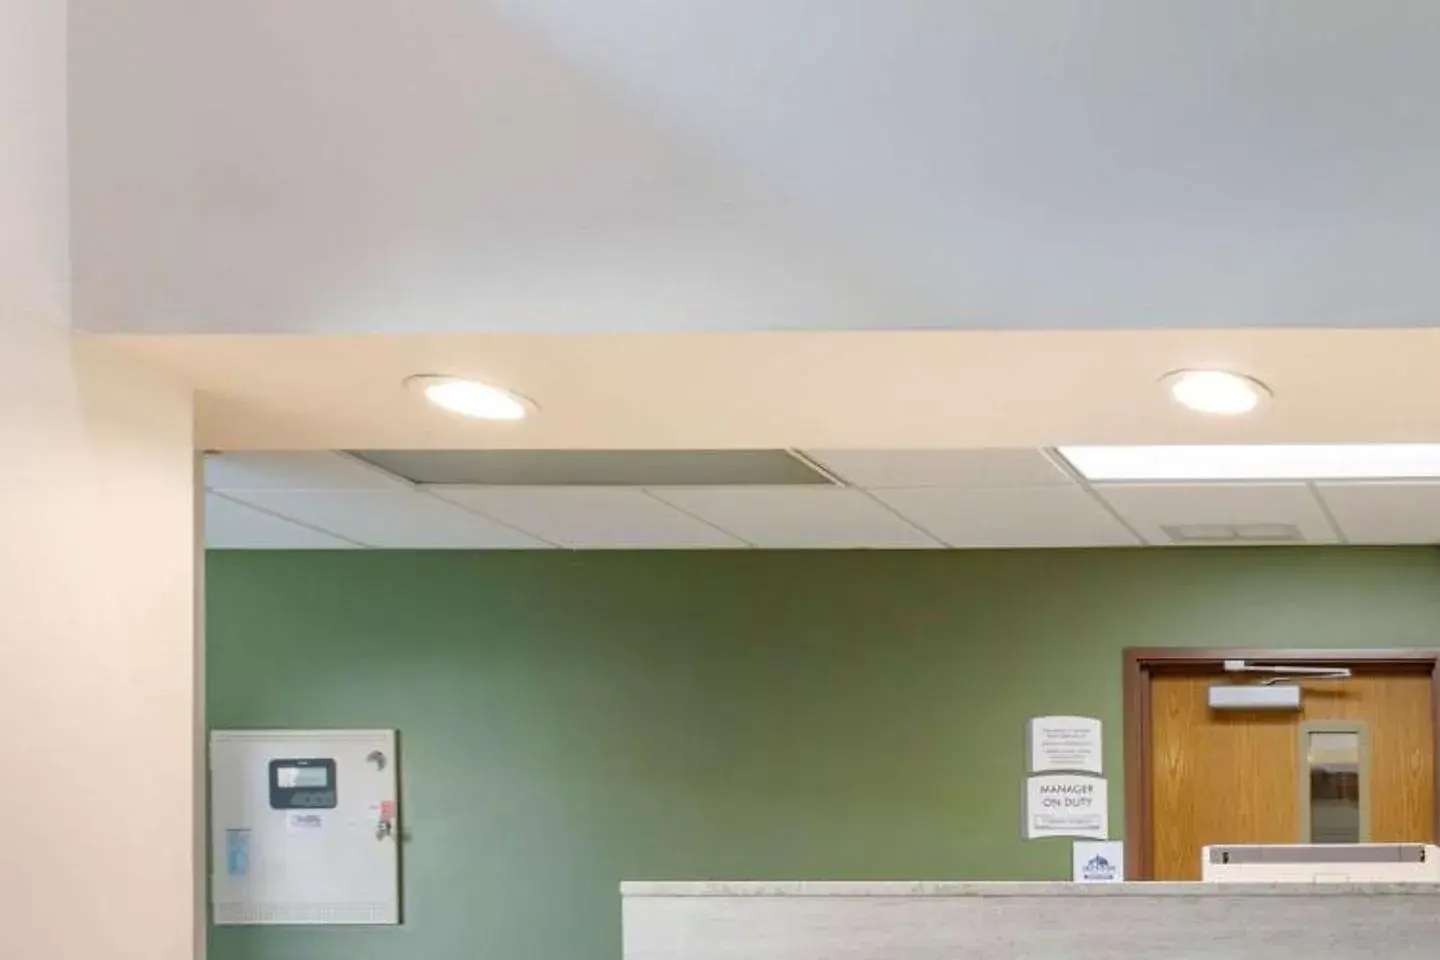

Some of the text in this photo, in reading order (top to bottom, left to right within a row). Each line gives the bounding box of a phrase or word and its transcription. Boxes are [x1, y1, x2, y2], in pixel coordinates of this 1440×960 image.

[1040, 784, 1094, 795] MANAGER
[1042, 797, 1093, 808] ON DUTY
